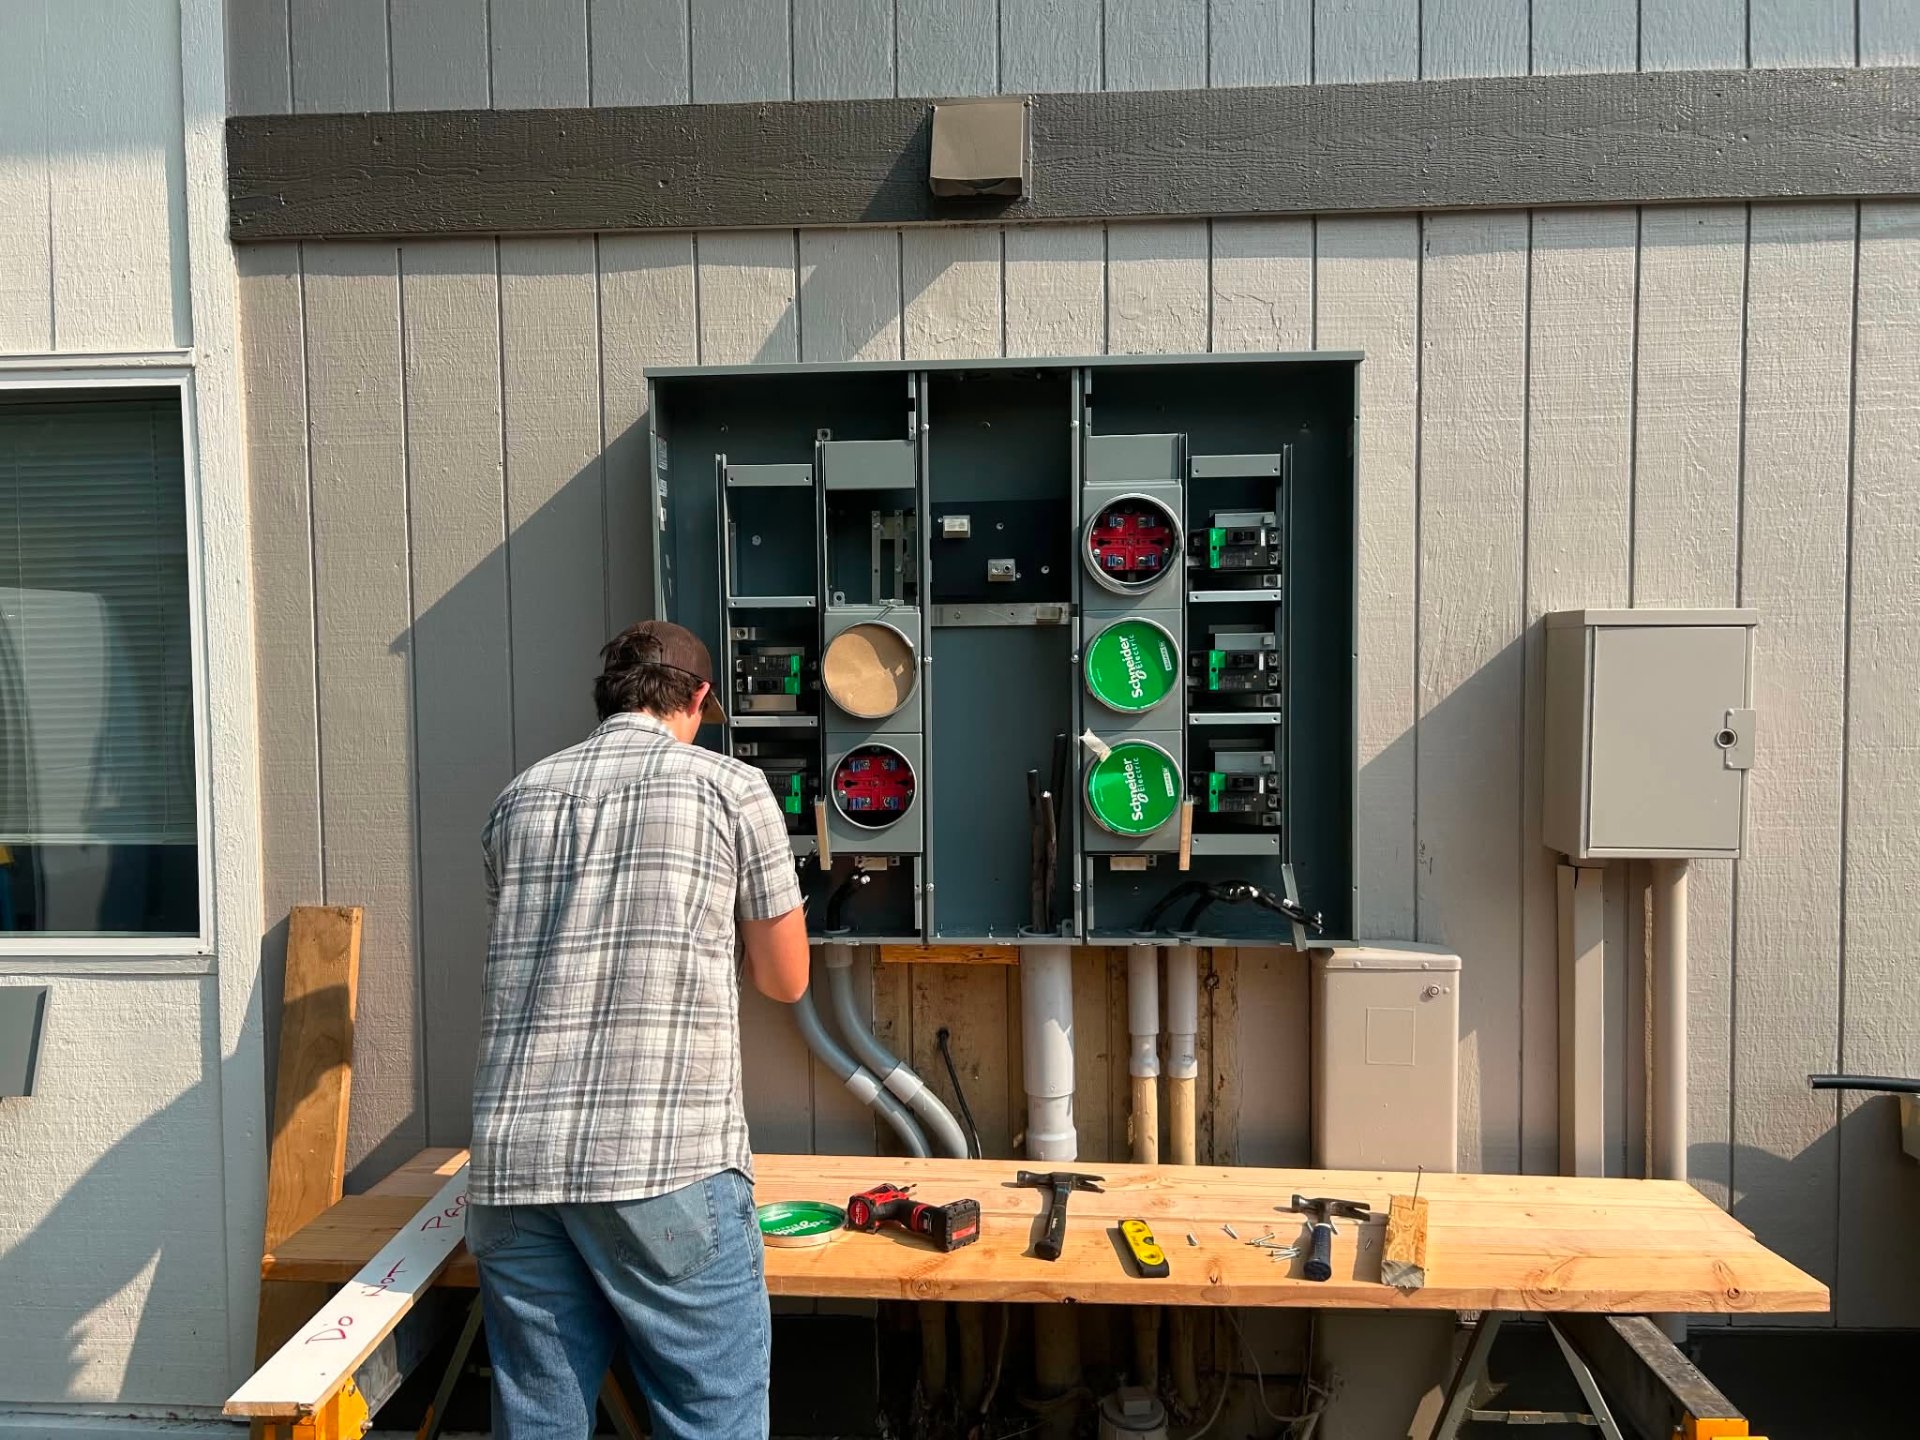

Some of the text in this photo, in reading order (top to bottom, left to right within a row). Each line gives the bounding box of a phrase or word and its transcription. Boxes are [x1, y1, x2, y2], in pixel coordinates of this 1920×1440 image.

[1119, 636, 1145, 698] Schneider
[1128, 634, 1143, 669] Electric
[1123, 758, 1145, 821] Schneider
[1132, 757, 1146, 792] Electric
